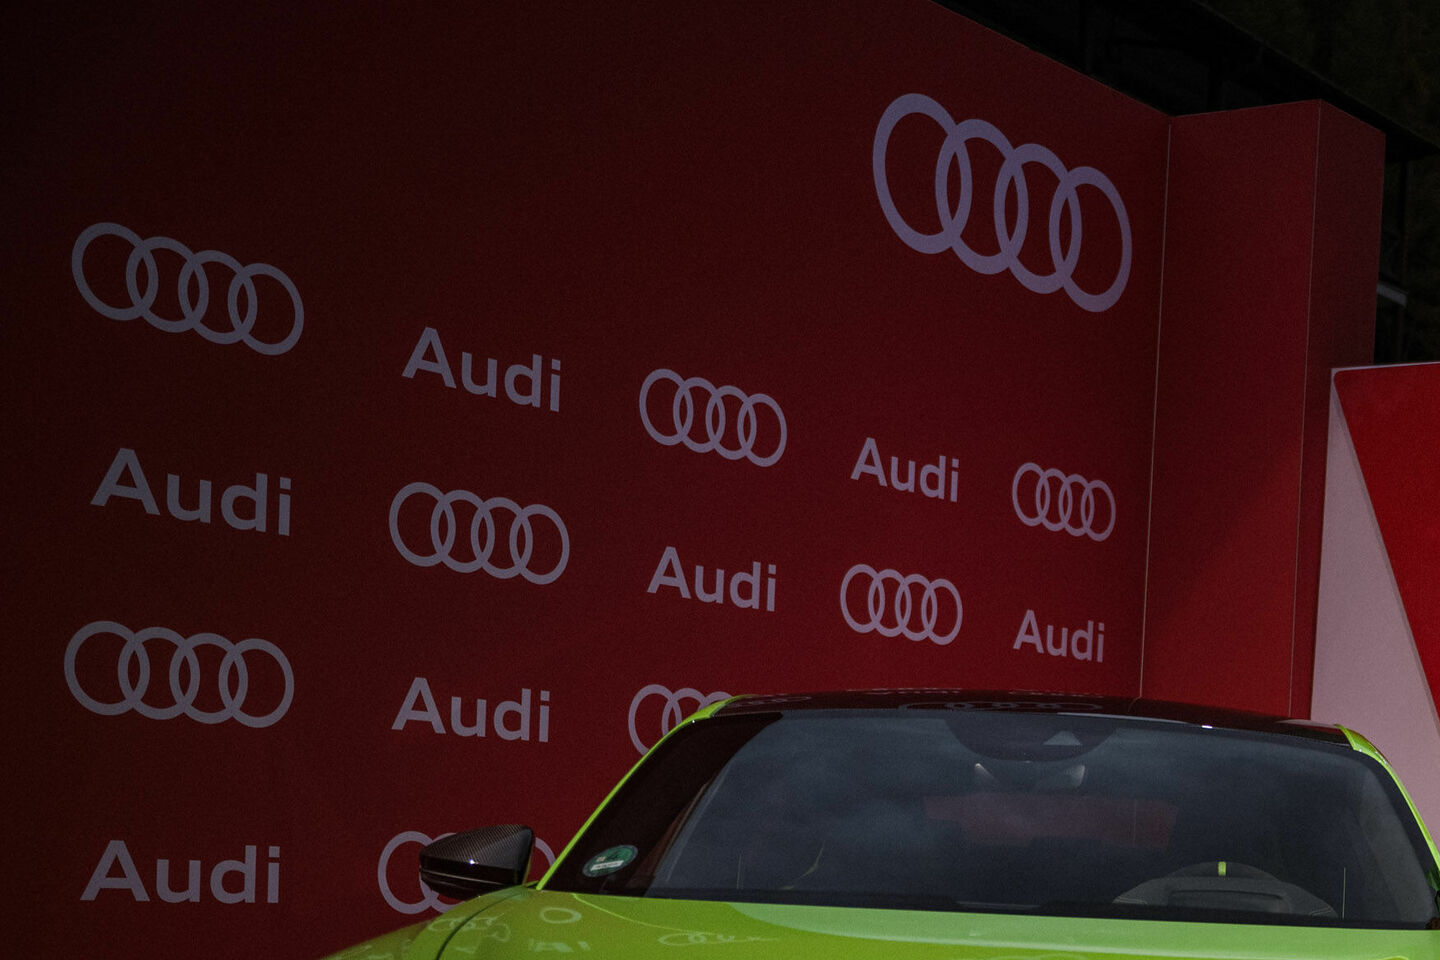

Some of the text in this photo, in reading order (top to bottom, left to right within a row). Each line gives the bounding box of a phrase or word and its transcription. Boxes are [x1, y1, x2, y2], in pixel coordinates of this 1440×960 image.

[402, 327, 561, 413] Audi
[91, 448, 292, 537] Audi
[852, 438, 960, 503] Audi
[648, 546, 778, 613] Audi
[1013, 609, 1105, 663] Audi
[391, 677, 551, 743] Audi
[80, 840, 280, 904] Audi
